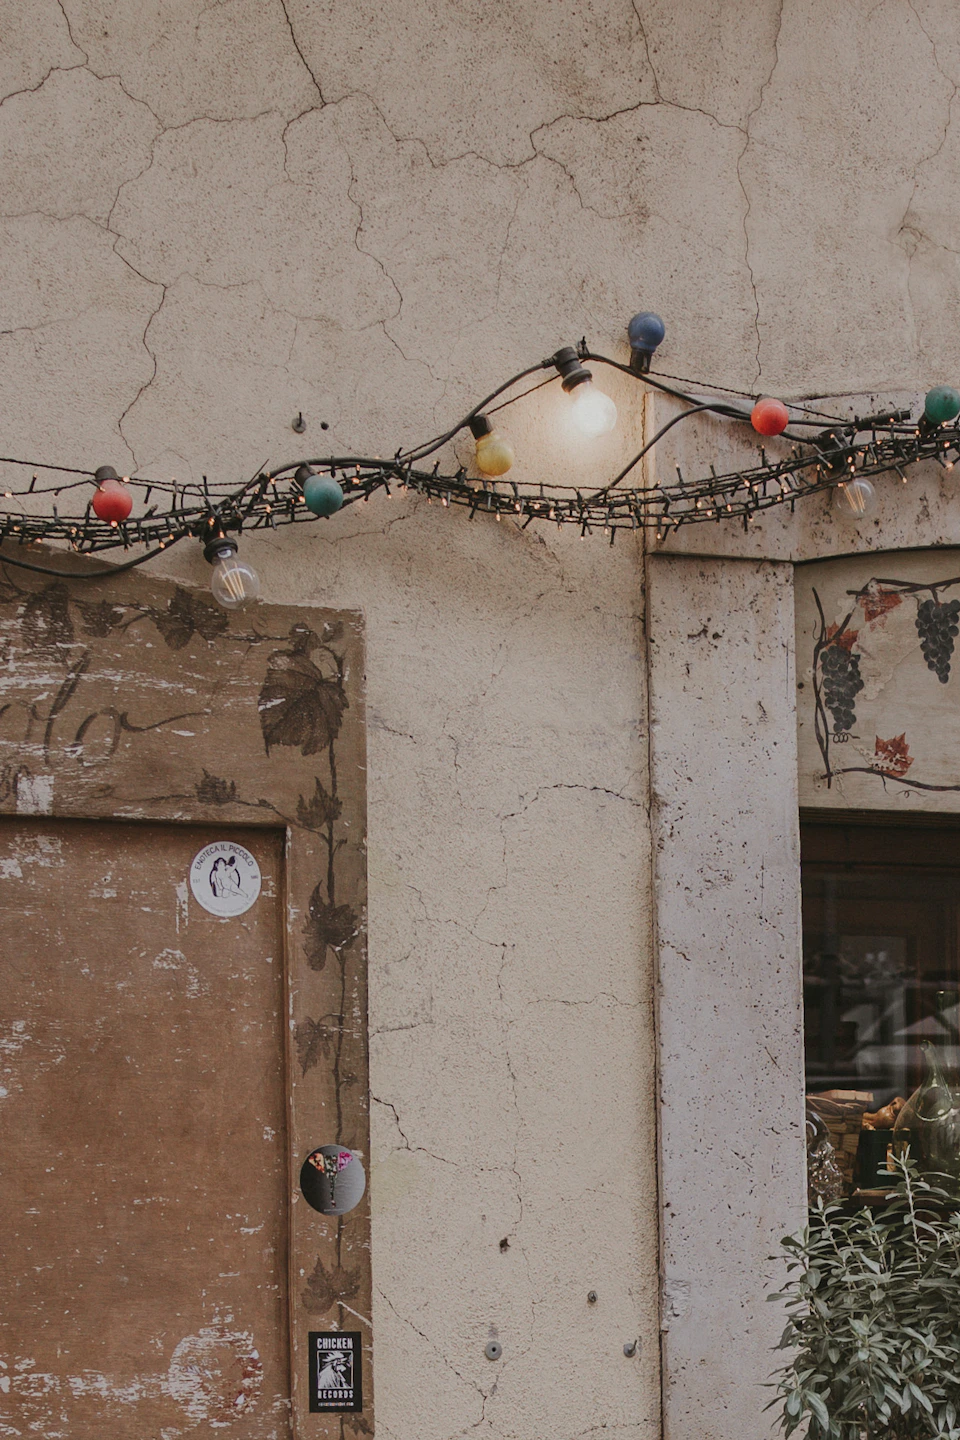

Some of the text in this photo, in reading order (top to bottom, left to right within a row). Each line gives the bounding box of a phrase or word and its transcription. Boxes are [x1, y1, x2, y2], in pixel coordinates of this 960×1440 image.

[194, 844, 254, 870] ENOTECA IL PICCOLO
[317, 1337, 354, 1350] CHICKEN
[317, 1389, 354, 1399] RECORDS
